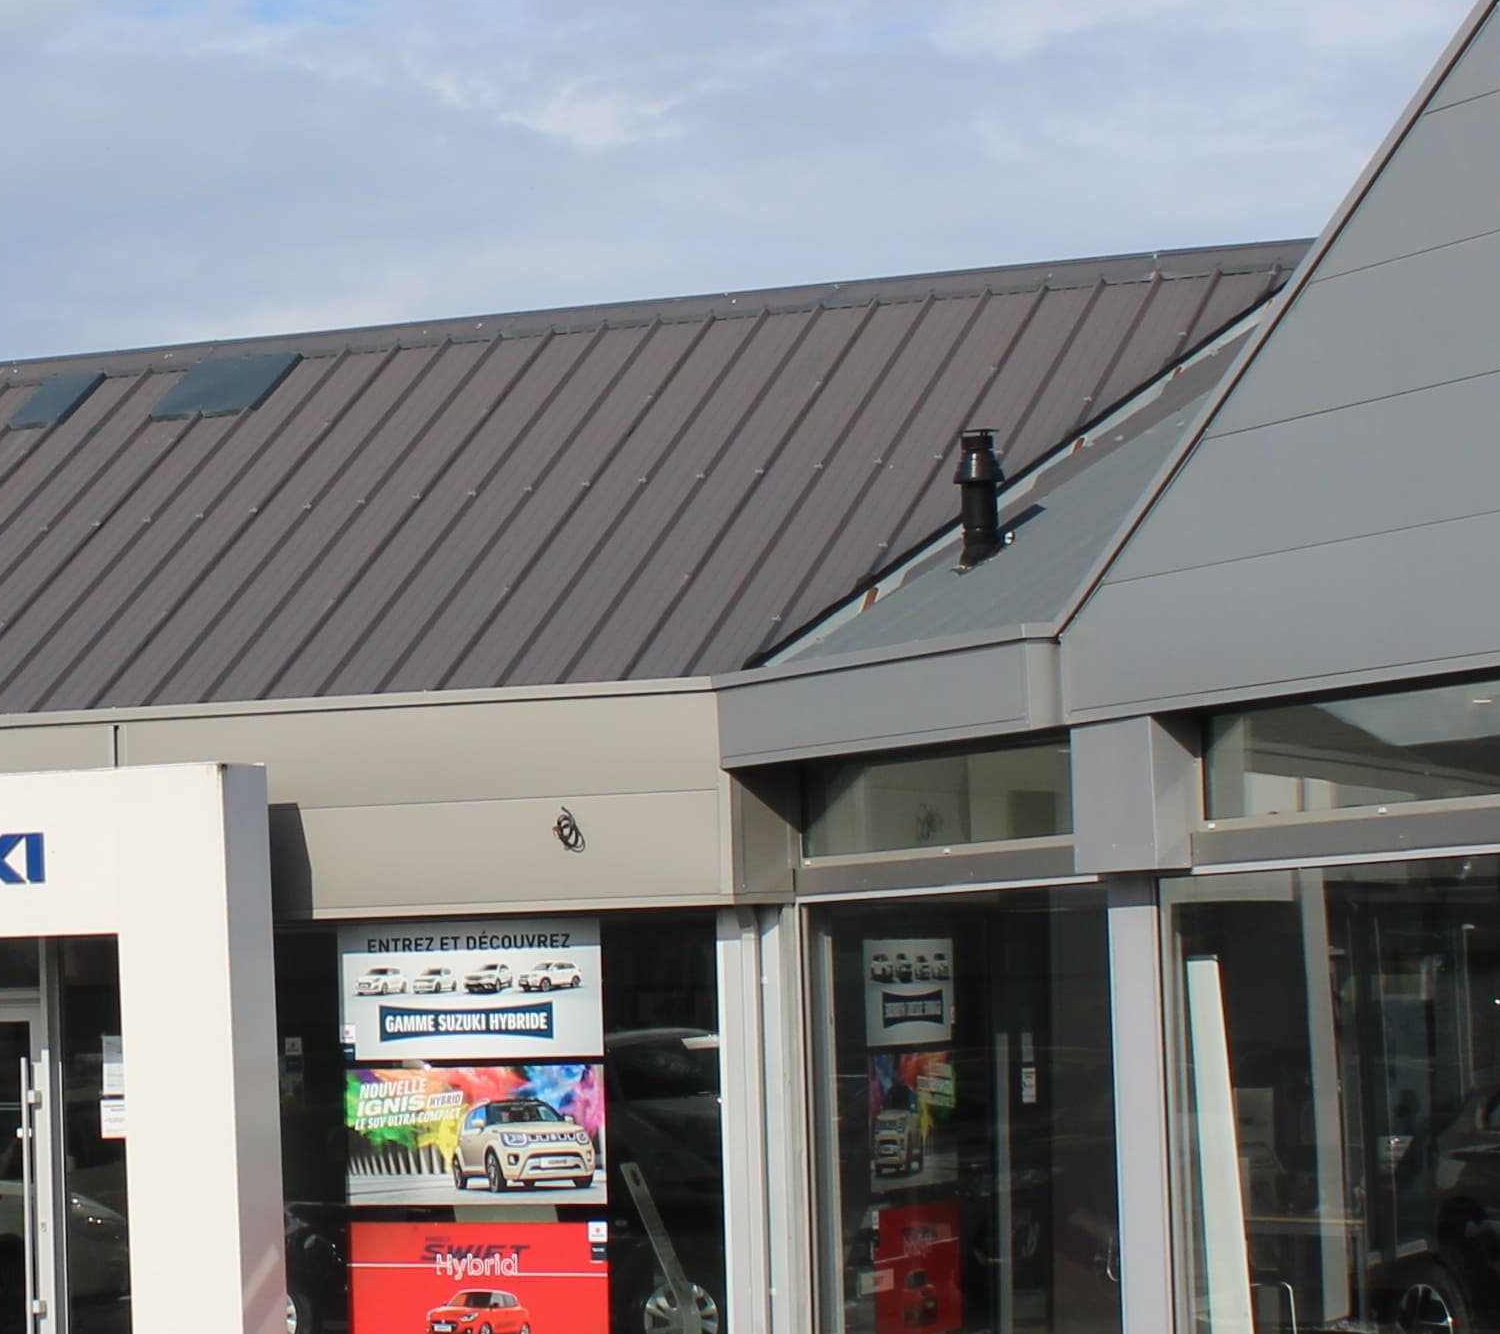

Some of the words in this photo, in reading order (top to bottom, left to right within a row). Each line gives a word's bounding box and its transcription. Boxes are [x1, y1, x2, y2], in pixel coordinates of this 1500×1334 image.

[367, 937, 435, 954] ENTREZ
[440, 936, 461, 952] ET
[466, 931, 571, 950] DÉCOUVREZ
[385, 1014, 435, 1033] GAMME
[438, 1013, 486, 1032] SUZUKI
[489, 1011, 547, 1030] HYBRIDE
[360, 1078, 428, 1099] NOUVELLE
[357, 1094, 425, 1117] IGNIS
[430, 1094, 461, 1107] HYBRID
[355, 1118, 366, 1130] LE
[368, 1116, 387, 1129] SUV
[387, 1112, 416, 1127] ULTRA
[417, 1107, 461, 1124] COMPACT
[420, 1244, 532, 1261] SWIFT
[436, 1253, 519, 1280] Hybrid
